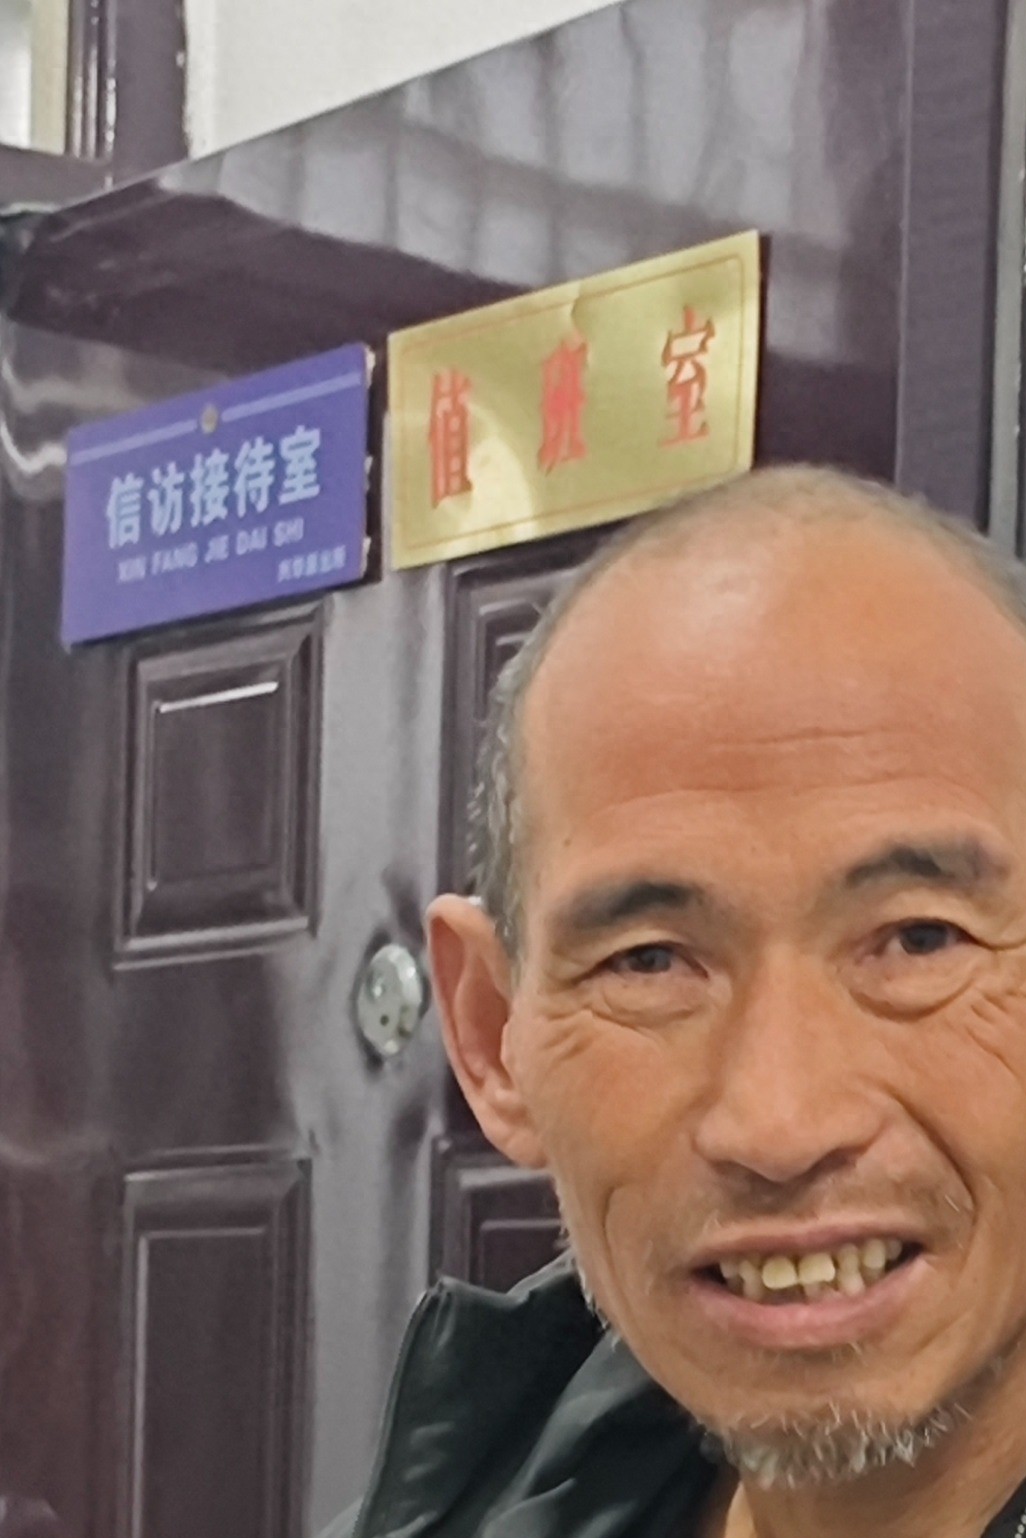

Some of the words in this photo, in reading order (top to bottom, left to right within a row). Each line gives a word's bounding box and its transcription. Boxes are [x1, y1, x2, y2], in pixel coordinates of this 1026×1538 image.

[106, 425, 321, 549] 信访接待室
[427, 306, 715, 508] 值班室
